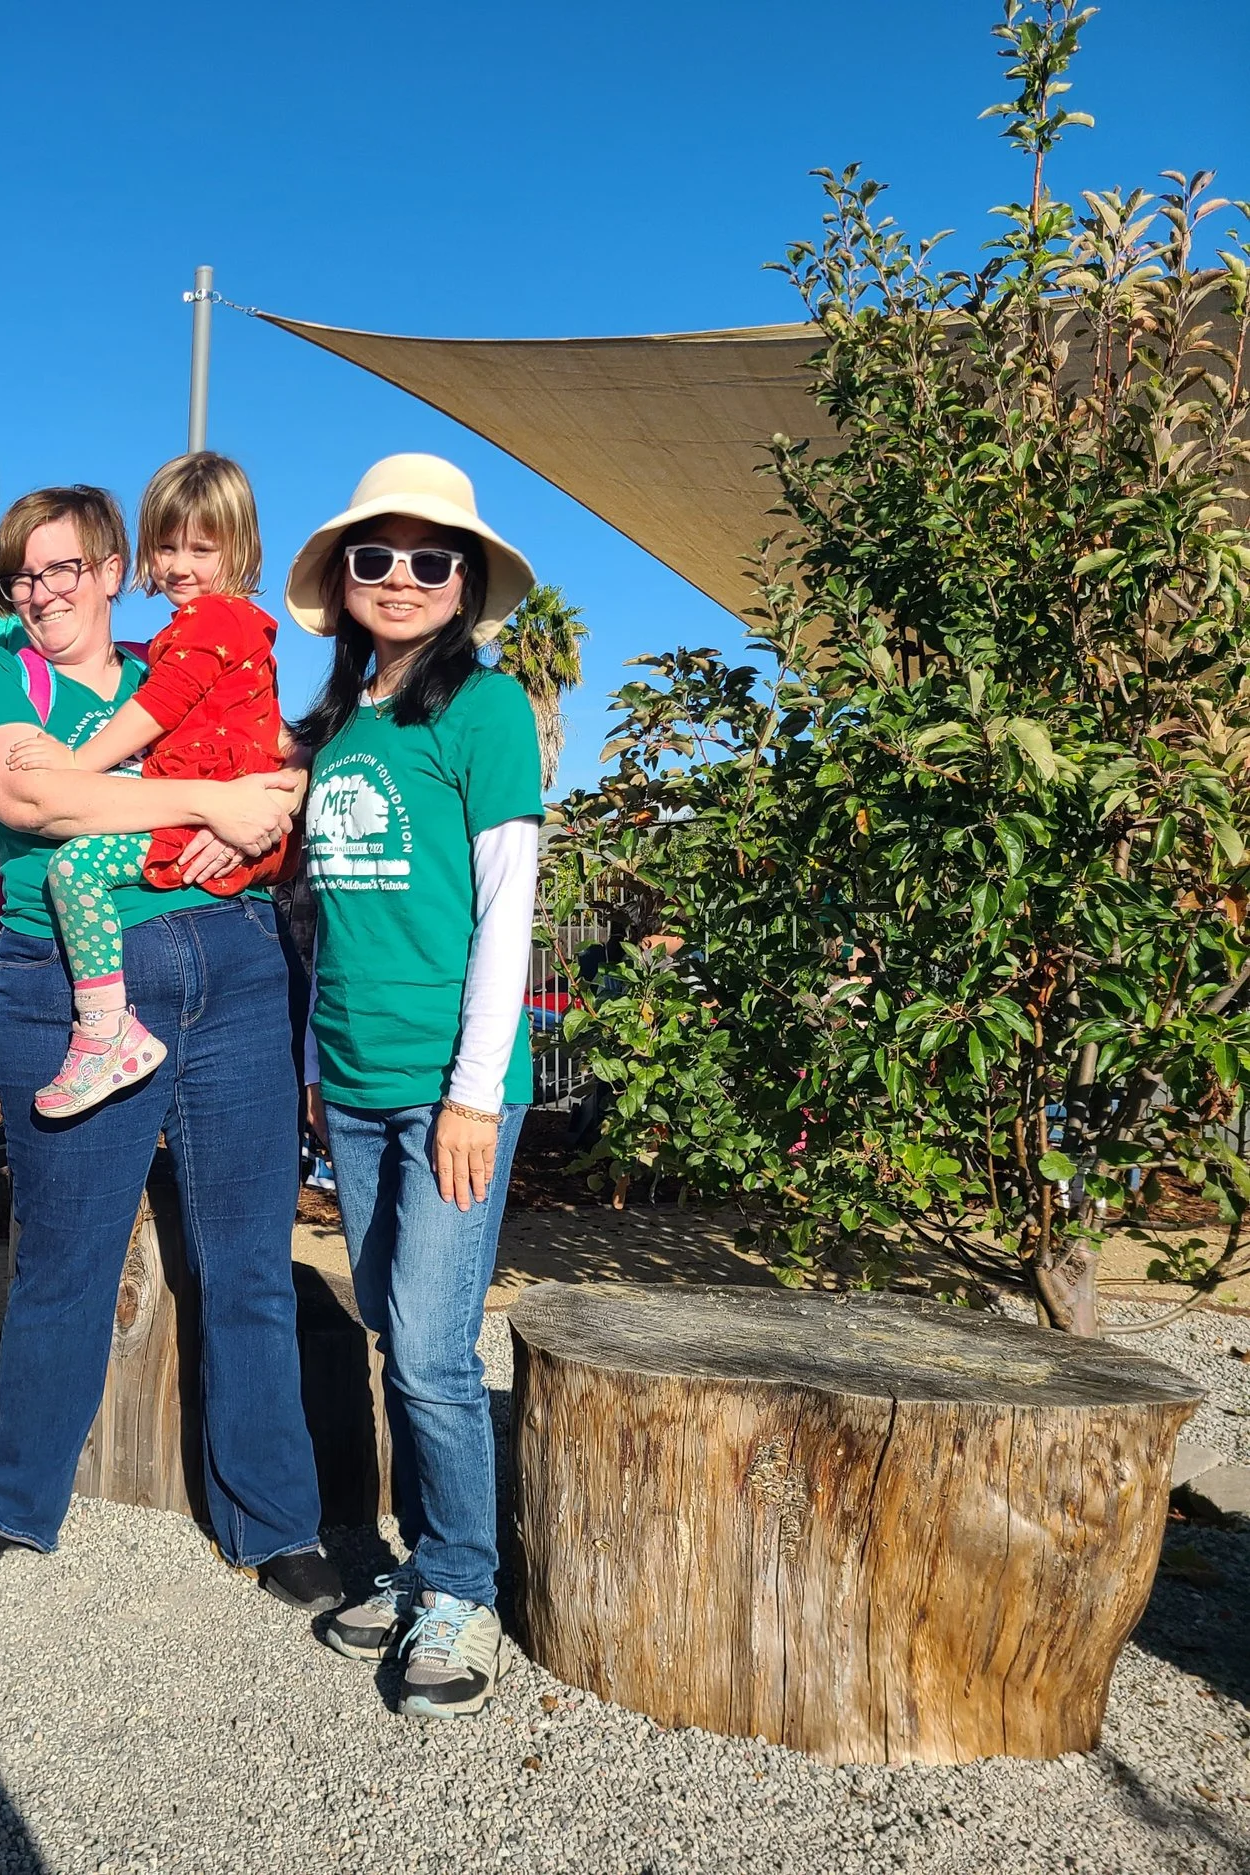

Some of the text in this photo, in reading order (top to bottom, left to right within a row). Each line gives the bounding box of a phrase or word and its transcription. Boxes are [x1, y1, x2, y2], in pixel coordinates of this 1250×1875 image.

[66, 711, 95, 751] RELAND
[321, 789, 359, 816] MEF
[321, 753, 413, 853] EDUCATION FOUNDATION
[378, 879, 410, 891] Future
